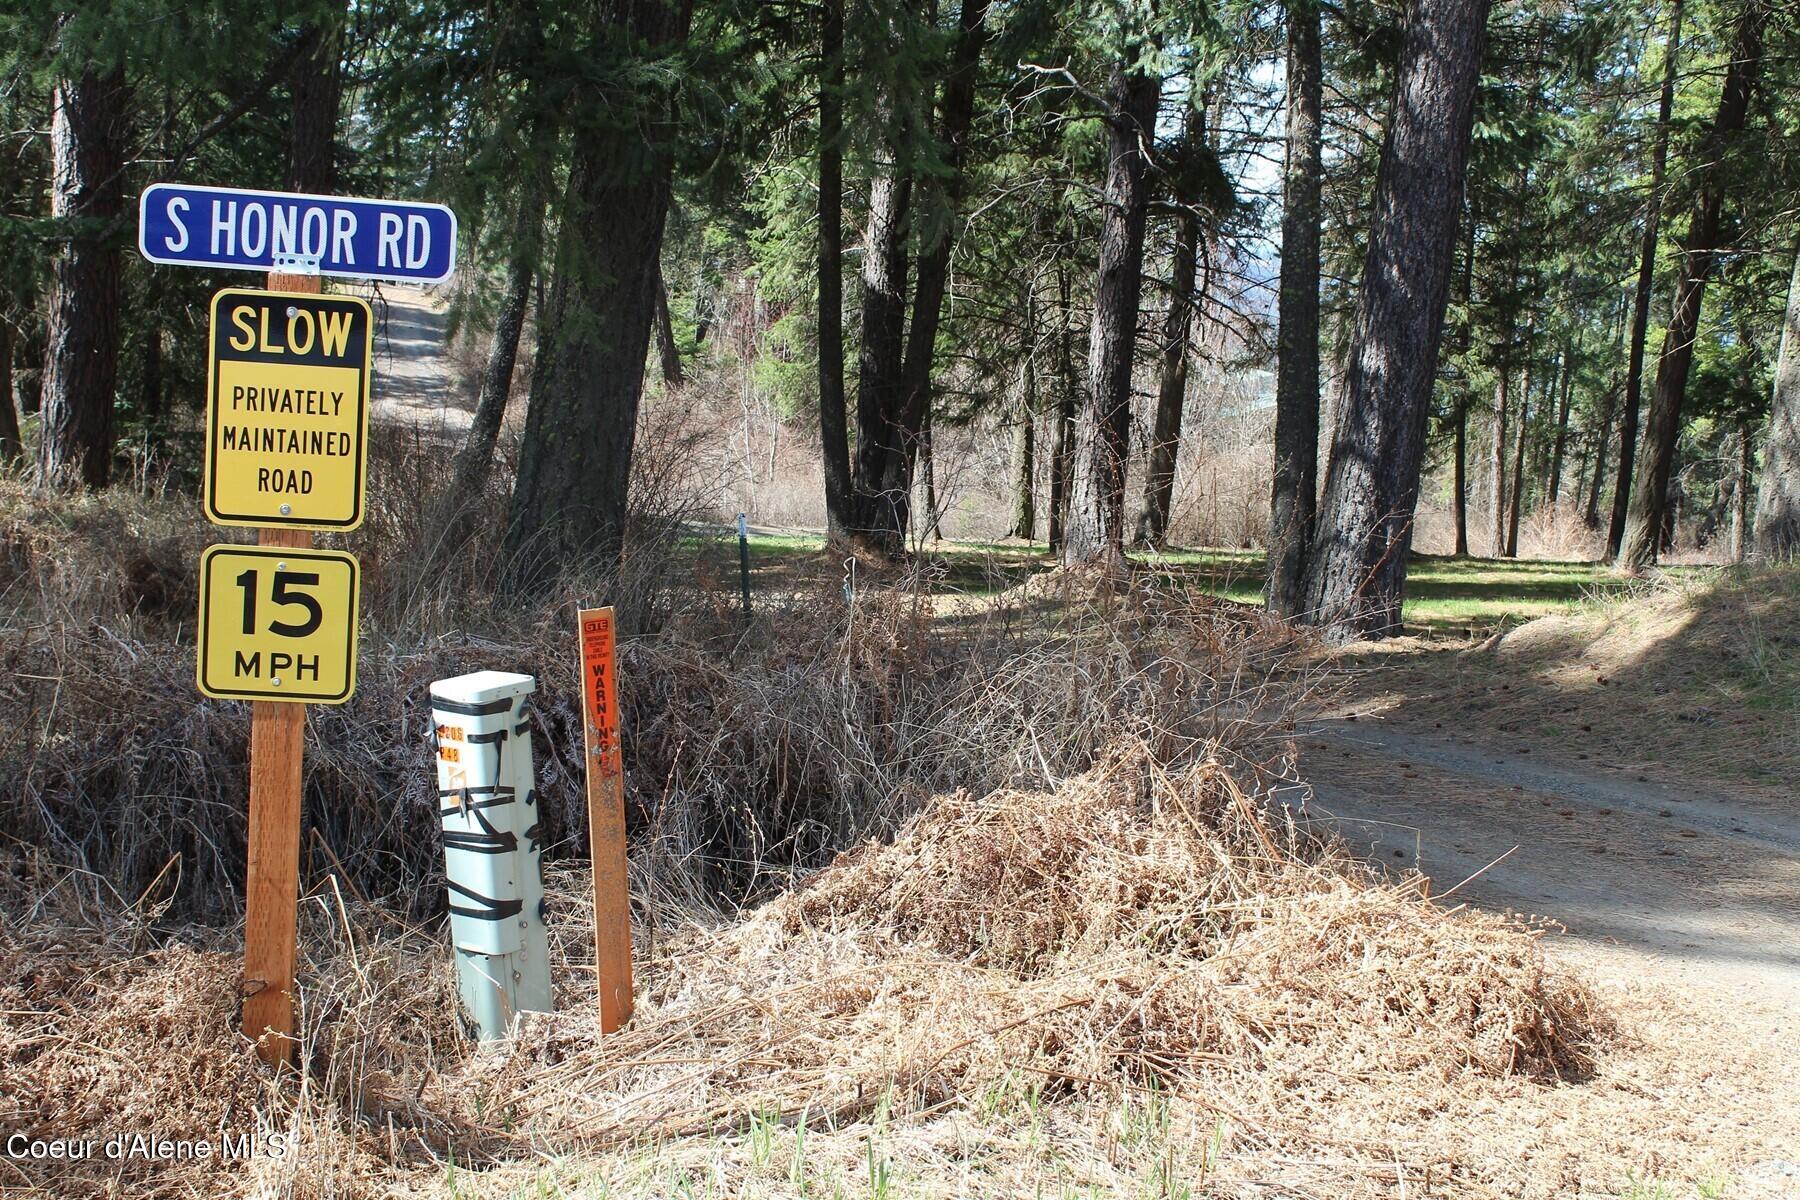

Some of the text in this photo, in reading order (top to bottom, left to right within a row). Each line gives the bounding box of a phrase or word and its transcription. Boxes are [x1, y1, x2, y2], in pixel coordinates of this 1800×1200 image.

[164, 196, 432, 270] S HONOR RD
[229, 305, 354, 358] SLOW
[232, 385, 344, 416] PRIVATELY
[222, 425, 351, 457] MAINTAINED
[257, 467, 313, 494] ROAD
[235, 568, 323, 638] 15
[585, 620, 608, 632] GTE
[233, 650, 320, 681] MPH
[592, 663, 609, 752] WARNING
